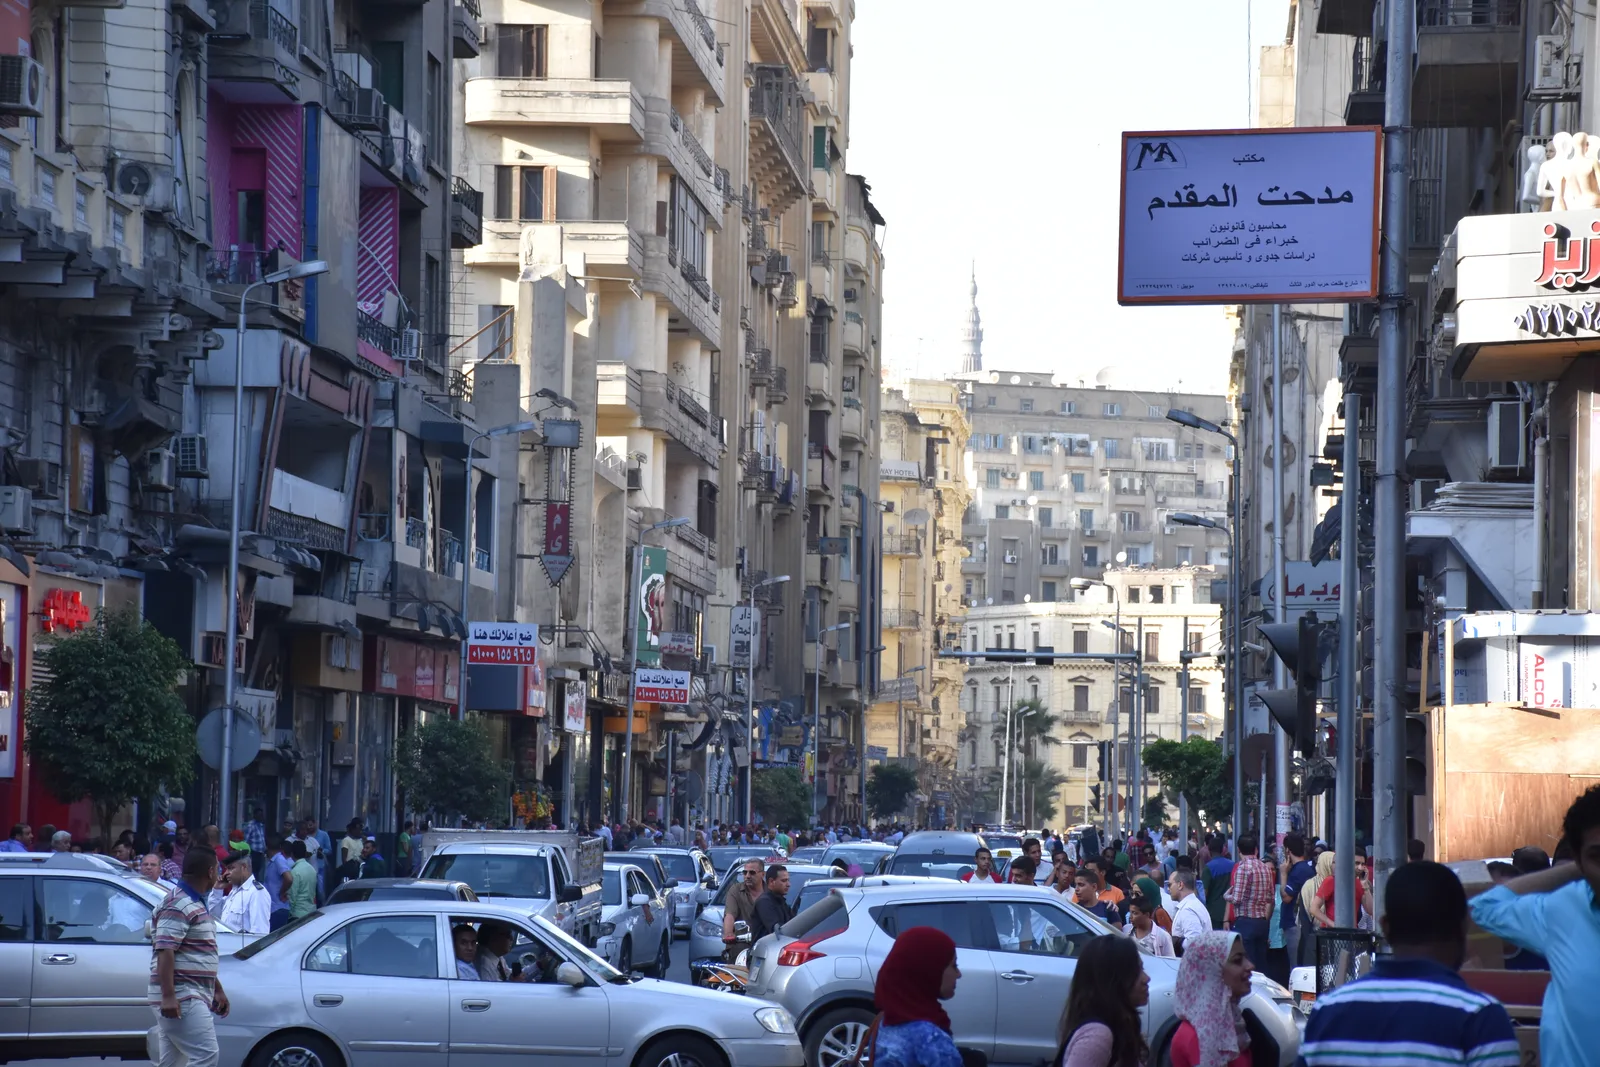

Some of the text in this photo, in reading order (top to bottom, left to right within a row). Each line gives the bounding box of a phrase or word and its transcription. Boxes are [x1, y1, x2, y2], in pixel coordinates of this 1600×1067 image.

[1233, 153, 1265, 165] مكتب
[1148, 183, 1353, 220] مدحت المقدم
[1210, 220, 1287, 233] محاسبون قانونيون
[1192, 236, 1239, 249] الضرائب
[1265, 236, 1298, 247] خبراء
[1181, 250, 1315, 264] دراسات جدوى و تأسيس شركات
[1344, 280, 1358, 288] شارع
[1514, 301, 1600, 333] ٠١٢١٠٢
[894, 469, 916, 477] HOTEL
[1309, 582, 1340, 602] وب
[474, 628, 532, 645] ضع أعلانك هنا
[497, 647, 511, 660] ١٥٥
[514, 648, 531, 662] ٩٦٥
[639, 673, 685, 688] ضع أعلانك هنا
[670, 689, 684, 701] ٩٦٥
